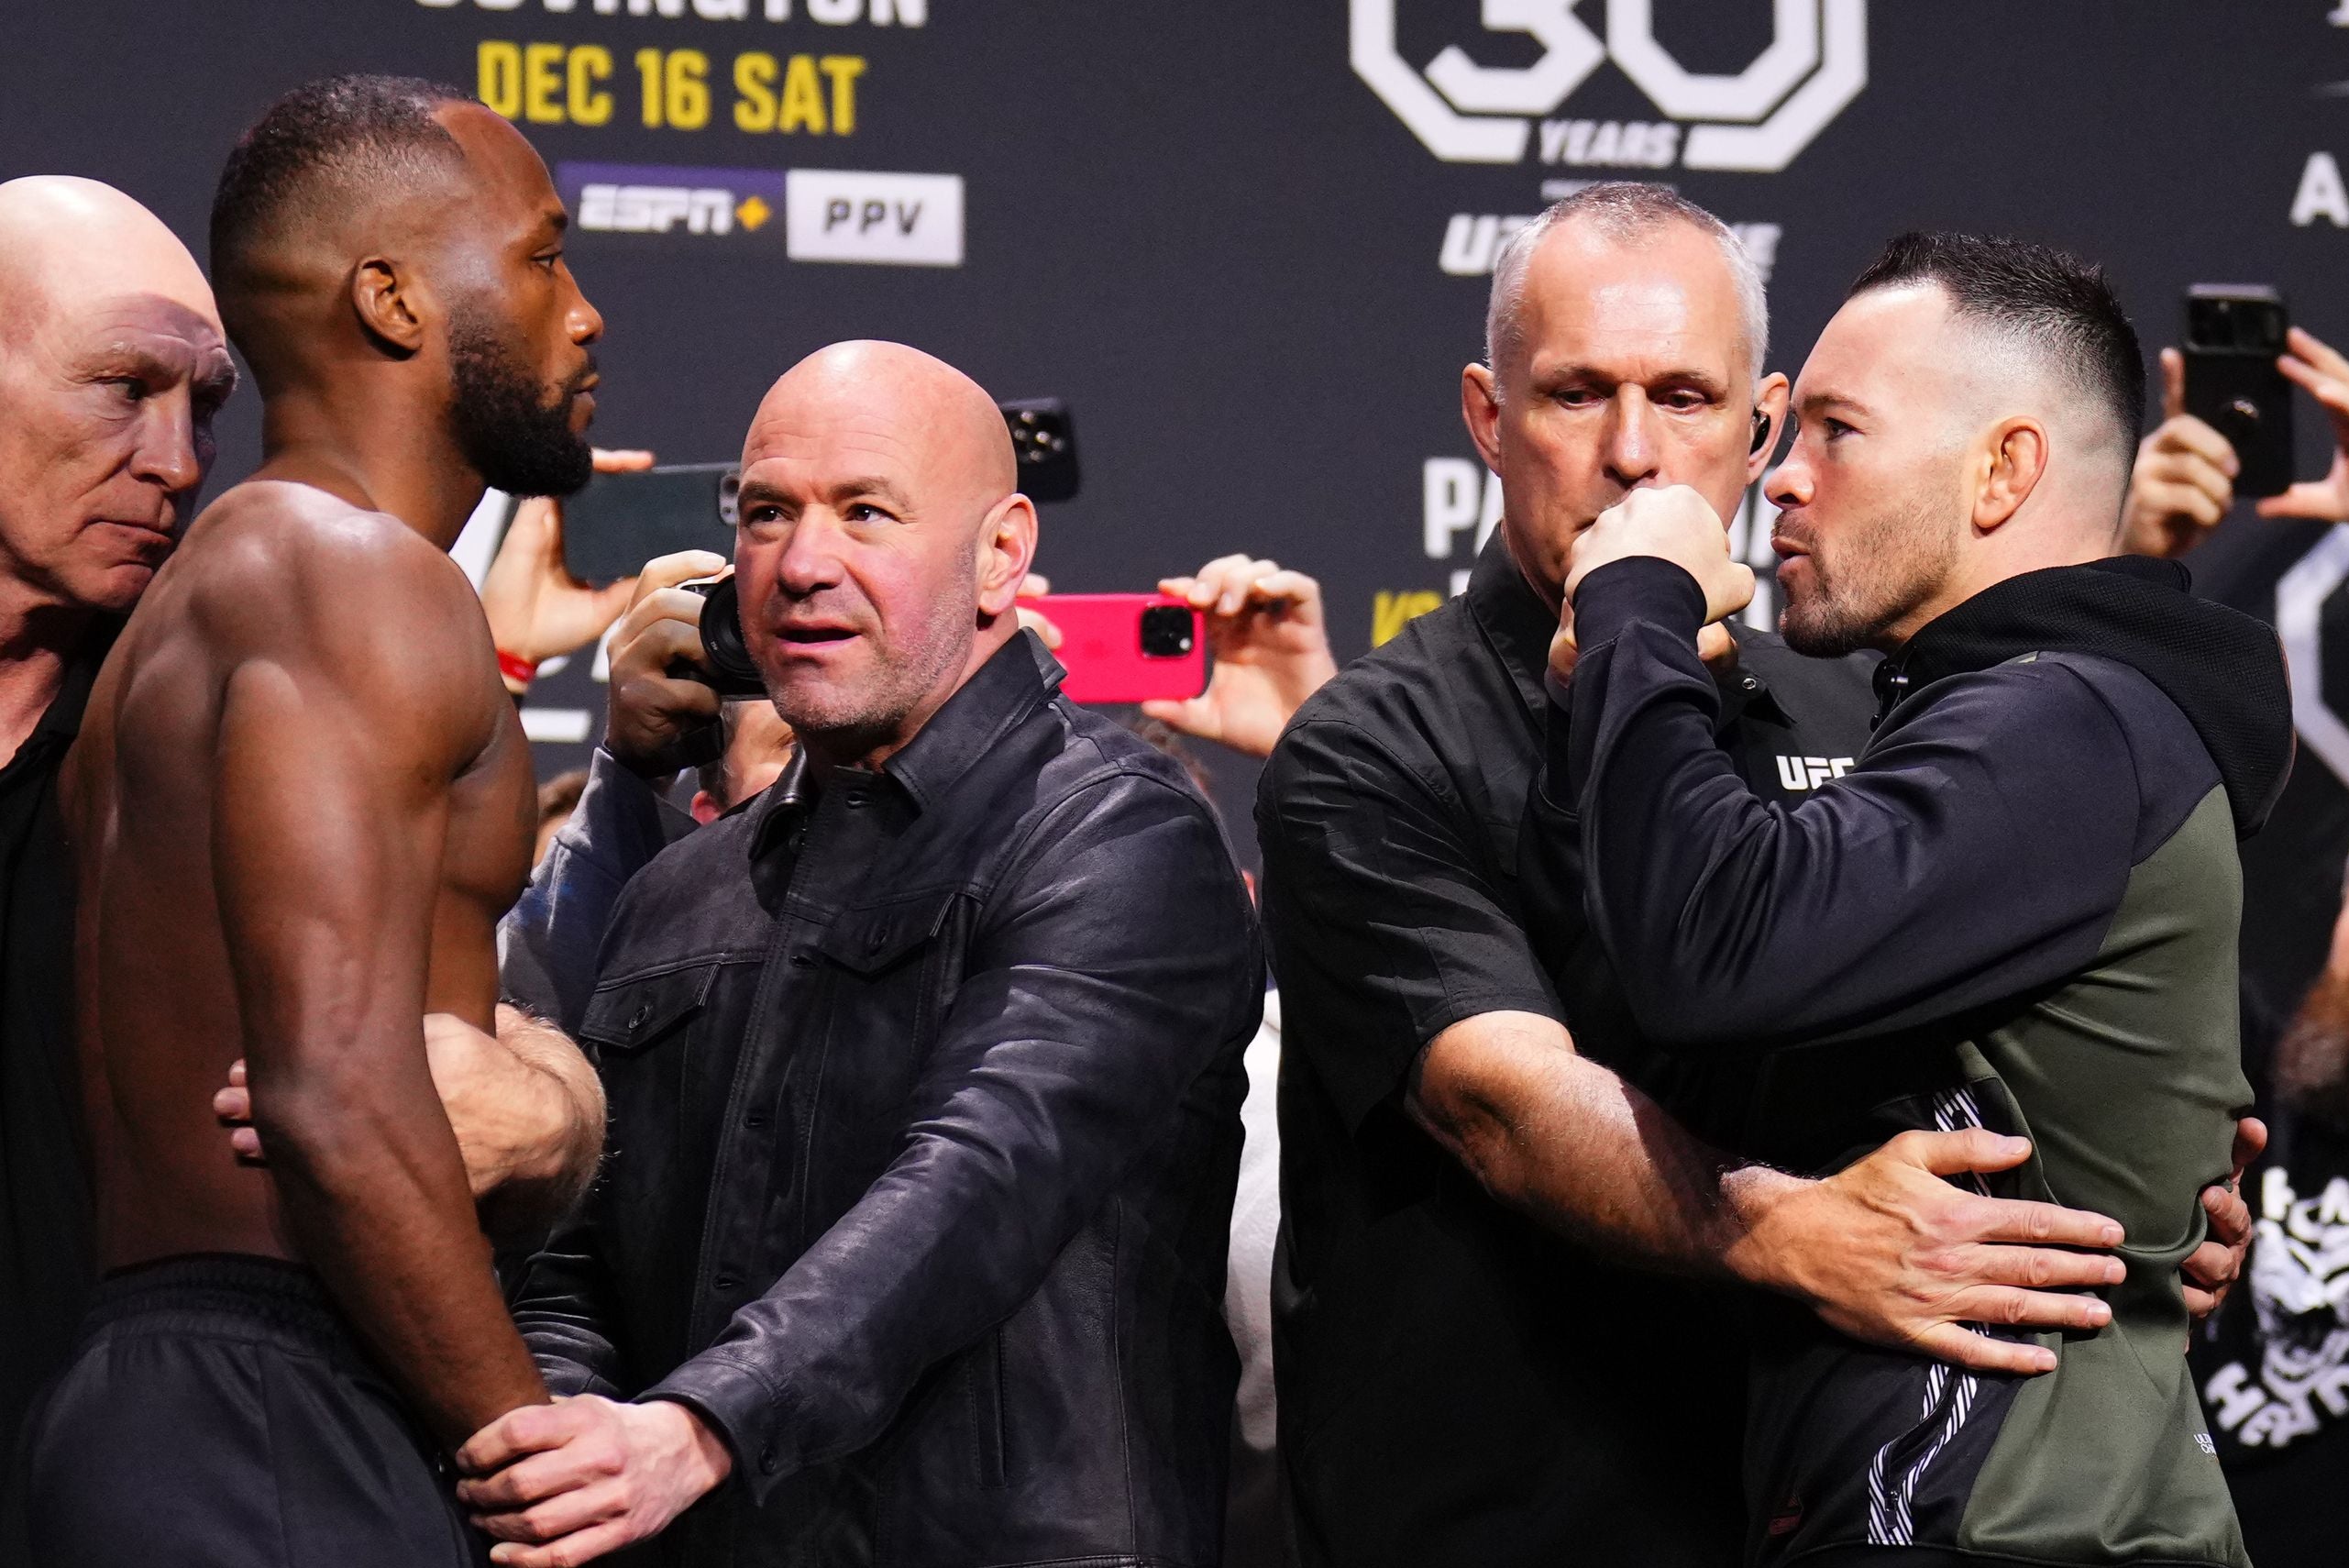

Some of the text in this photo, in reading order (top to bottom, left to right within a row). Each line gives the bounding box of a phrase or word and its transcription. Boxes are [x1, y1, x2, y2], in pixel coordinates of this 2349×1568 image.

[477, 39, 867, 138] DEC 16 SAT
[1538, 118, 1680, 170] YEARS
[823, 195, 923, 237] PPV
